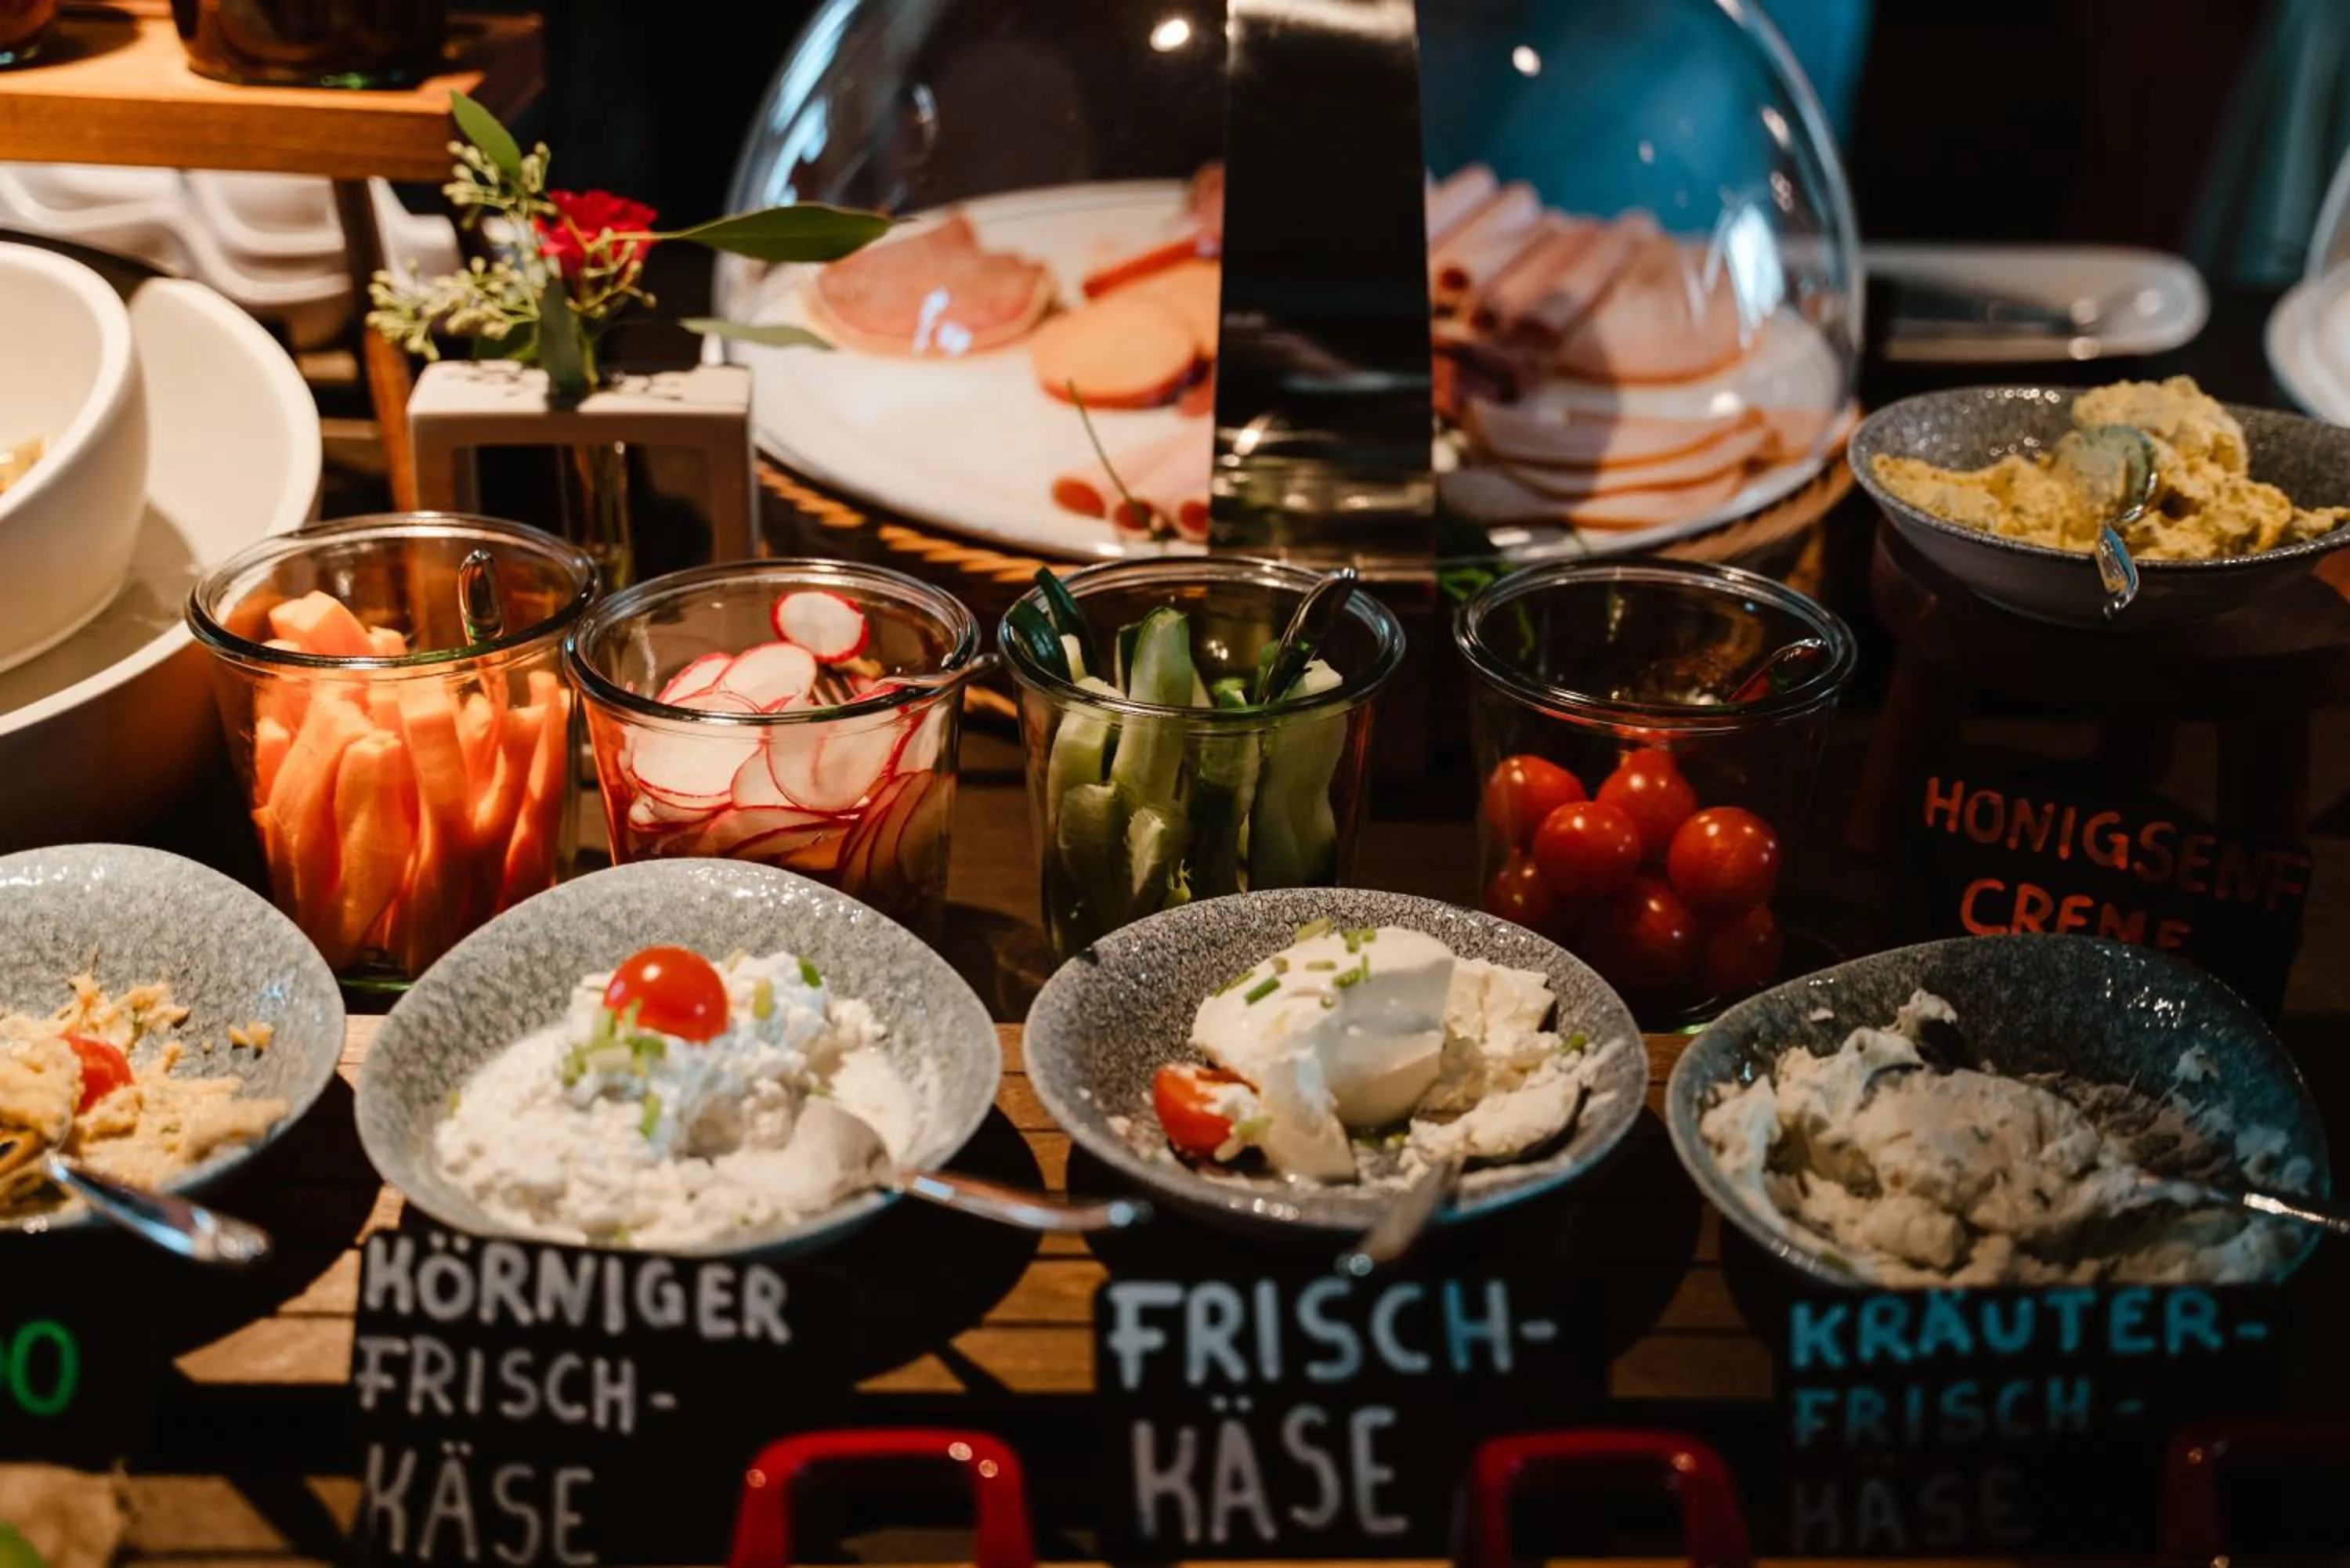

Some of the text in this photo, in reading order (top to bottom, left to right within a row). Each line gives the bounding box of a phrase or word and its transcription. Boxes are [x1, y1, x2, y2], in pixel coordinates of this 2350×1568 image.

[1922, 775, 2311, 912] HONIGSENF
[363, 1230, 792, 1346] KÖRNIGER
[1104, 1274, 1559, 1391] FRISCH-
[352, 1333, 679, 1436] FRISCH-
[1791, 1373, 2145, 1451] FRISCH-
[363, 1439, 601, 1566] KÄSE
[1129, 1395, 1412, 1544] KÄSE
